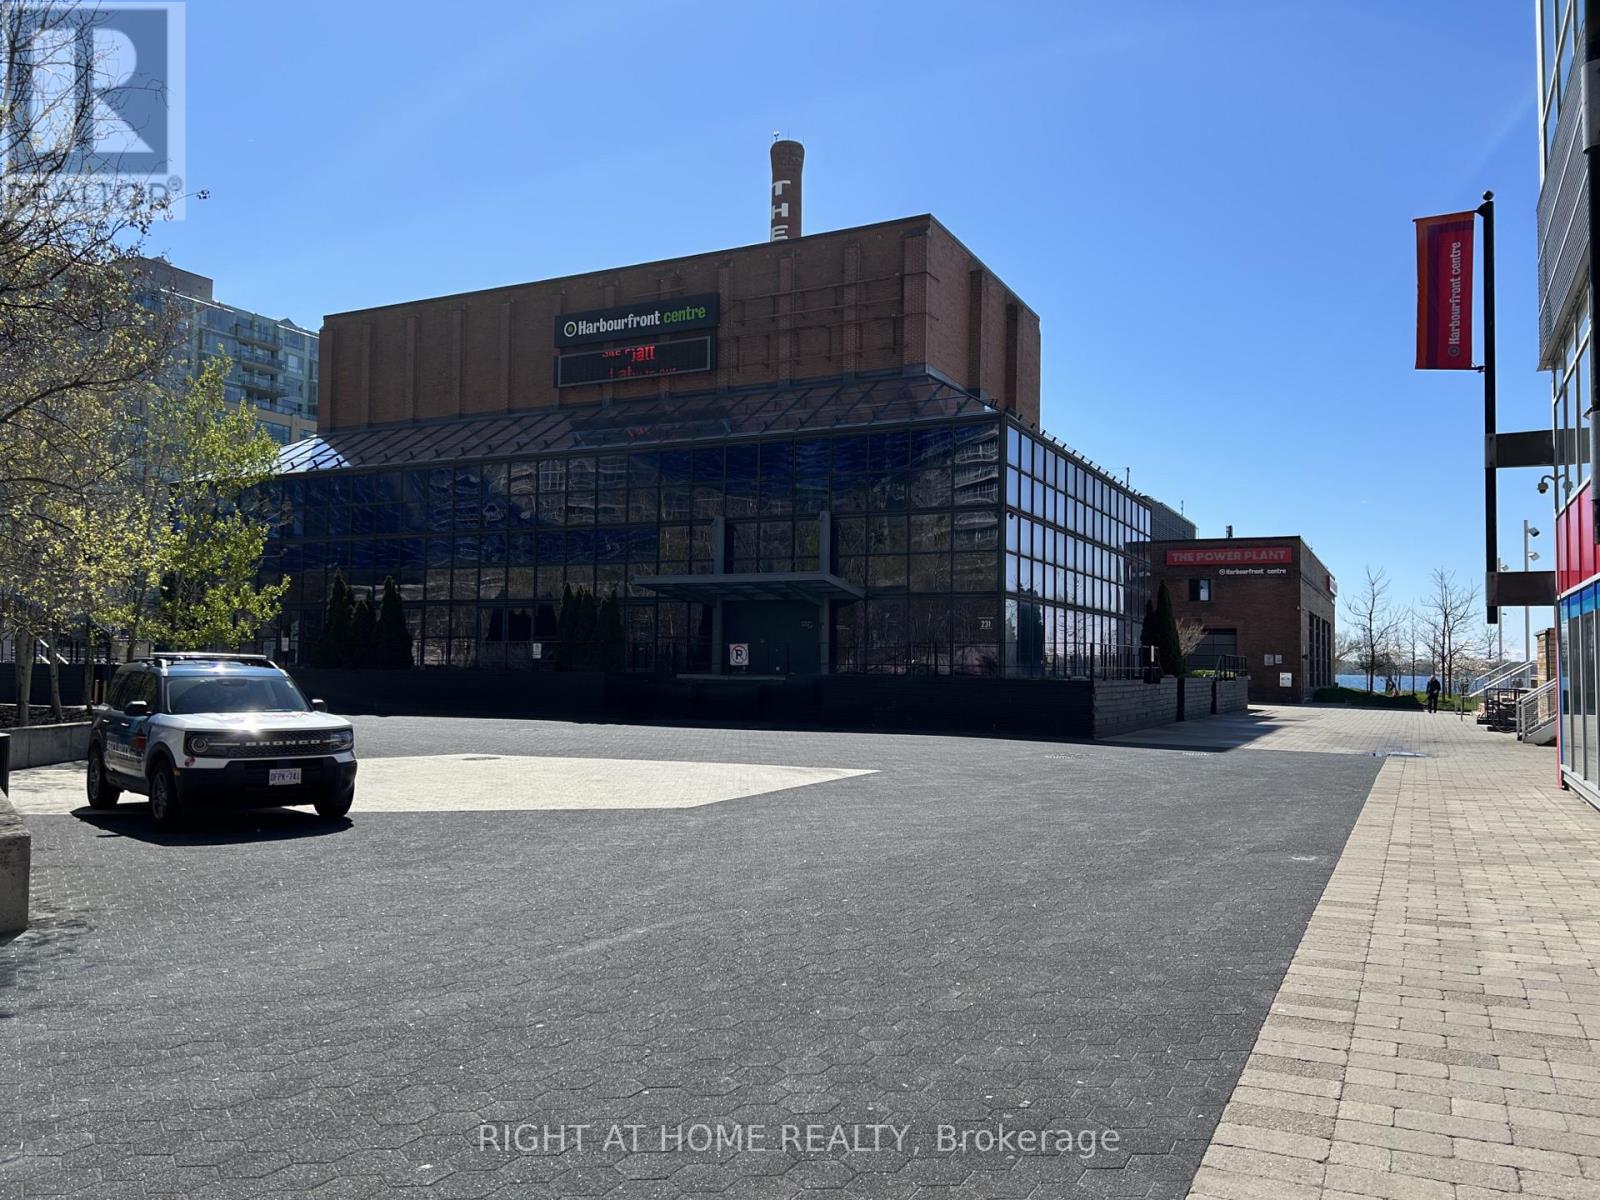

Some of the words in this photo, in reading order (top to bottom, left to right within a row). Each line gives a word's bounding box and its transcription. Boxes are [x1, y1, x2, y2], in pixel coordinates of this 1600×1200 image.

[1450, 241, 1461, 275] centre
[578, 310, 661, 335] Harbourfront
[663, 306, 706, 323] centre
[1449, 276, 1461, 345] Harbourfront
[1172, 552, 1195, 562] THE
[1196, 551, 1241, 562] POWER
[1244, 550, 1286, 560] PLANT
[245, 739, 321, 747] BRONCO
